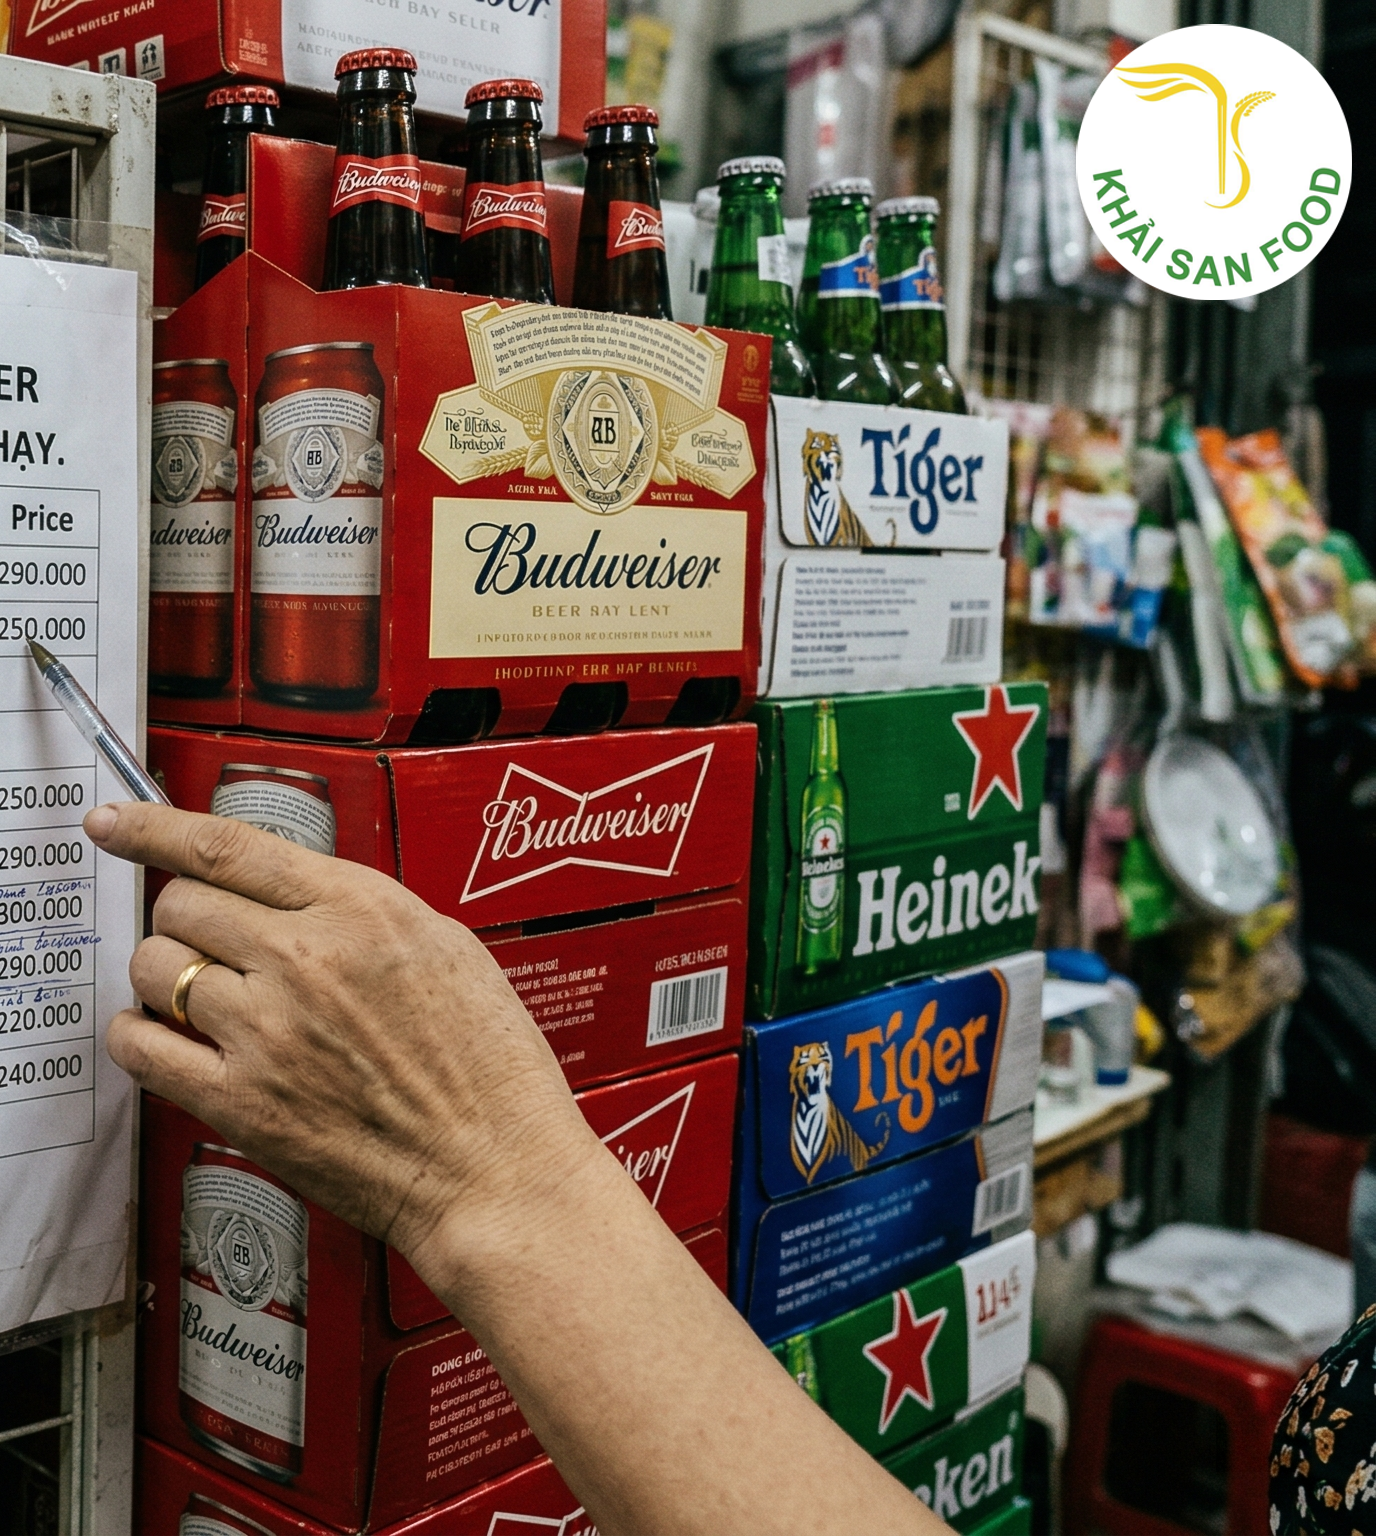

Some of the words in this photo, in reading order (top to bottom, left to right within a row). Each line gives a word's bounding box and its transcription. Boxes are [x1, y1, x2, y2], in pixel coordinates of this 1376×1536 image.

[860, 424, 984, 535] Tiger
[11, 503, 74, 533] Price
[255, 513, 380, 548] Budweiser
[465, 522, 721, 596] Budweiser
[532, 605, 581, 617] BEER
[629, 604, 672, 617] LENT
[482, 791, 690, 861] Budweiser
[852, 840, 1042, 957] Heinek
[844, 1000, 988, 1134] Tiger
[180, 1297, 305, 1382] Budweiser
